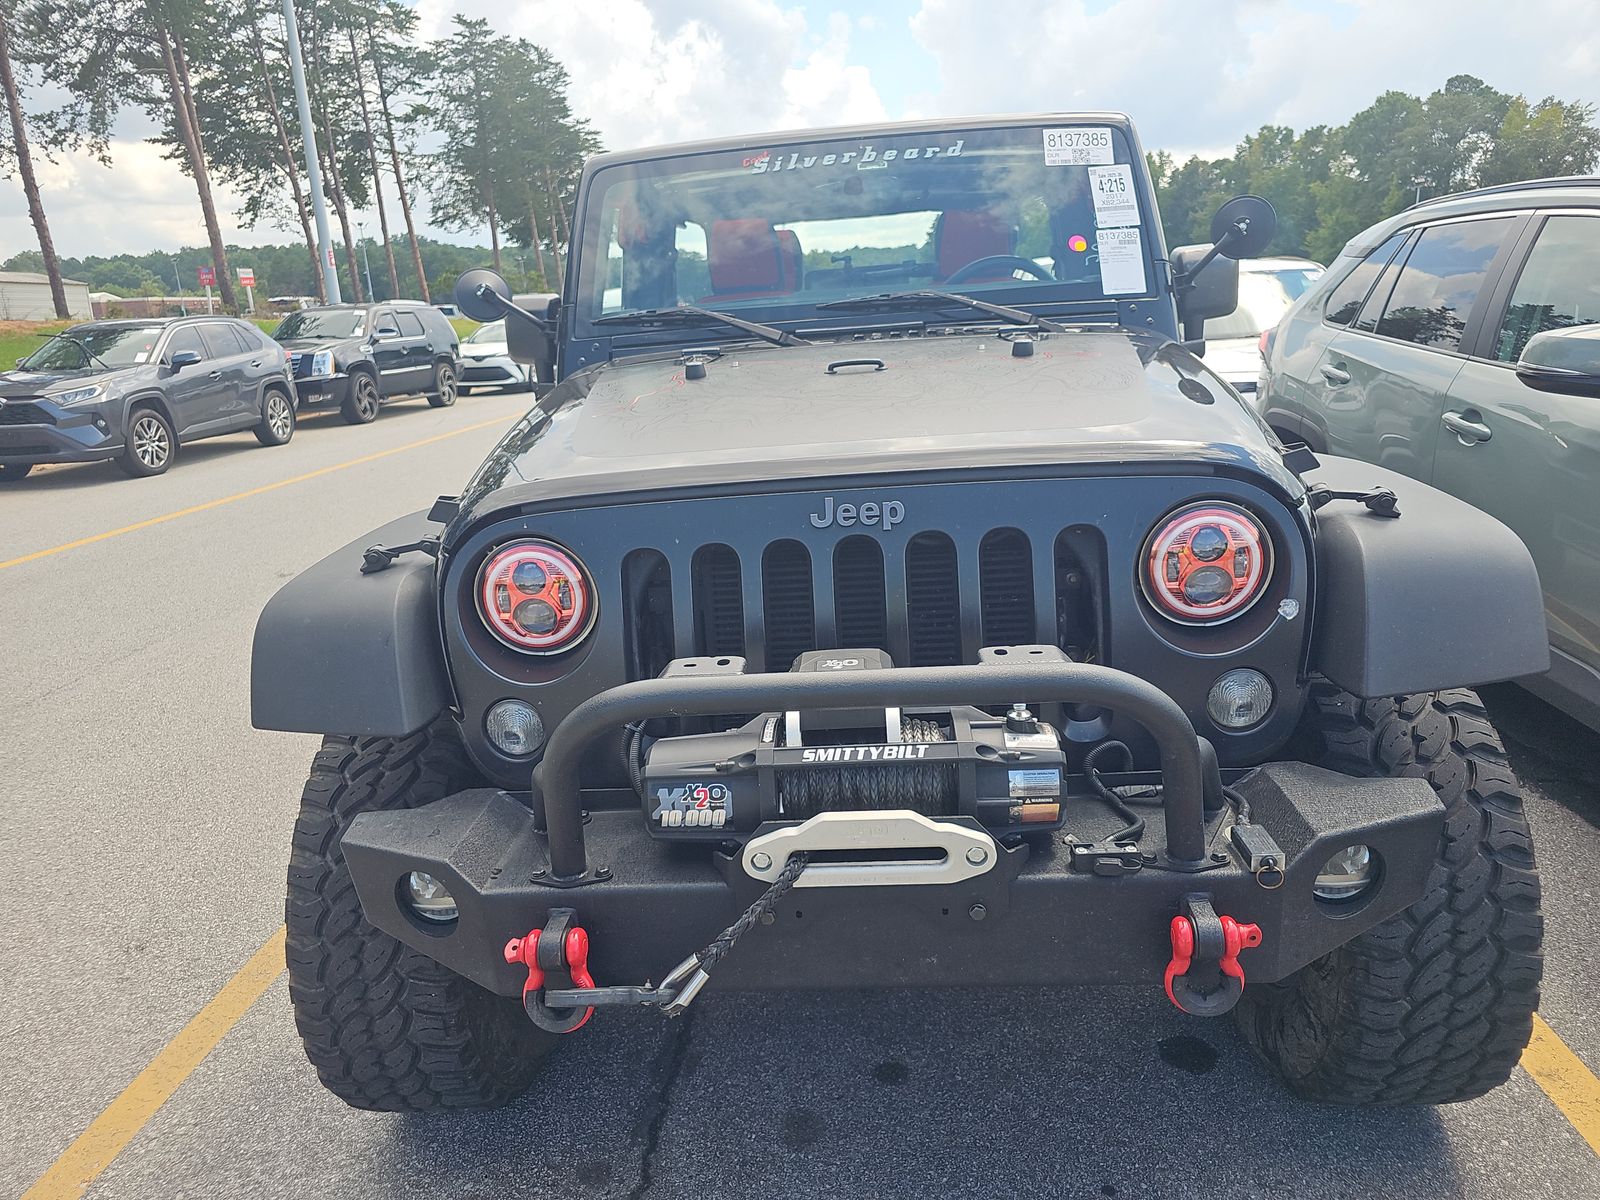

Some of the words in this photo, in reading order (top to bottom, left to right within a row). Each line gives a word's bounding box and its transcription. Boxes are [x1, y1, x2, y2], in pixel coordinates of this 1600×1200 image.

[1047, 132, 1108, 148] 8137385
[751, 140, 965, 174] Silverbeard
[1099, 178, 1126, 193] 4:215
[1098, 231, 1138, 241] 8137385
[810, 497, 905, 531] Jeep
[801, 745, 929, 762] SMITTYBILT
[661, 809, 727, 827] 10,000
